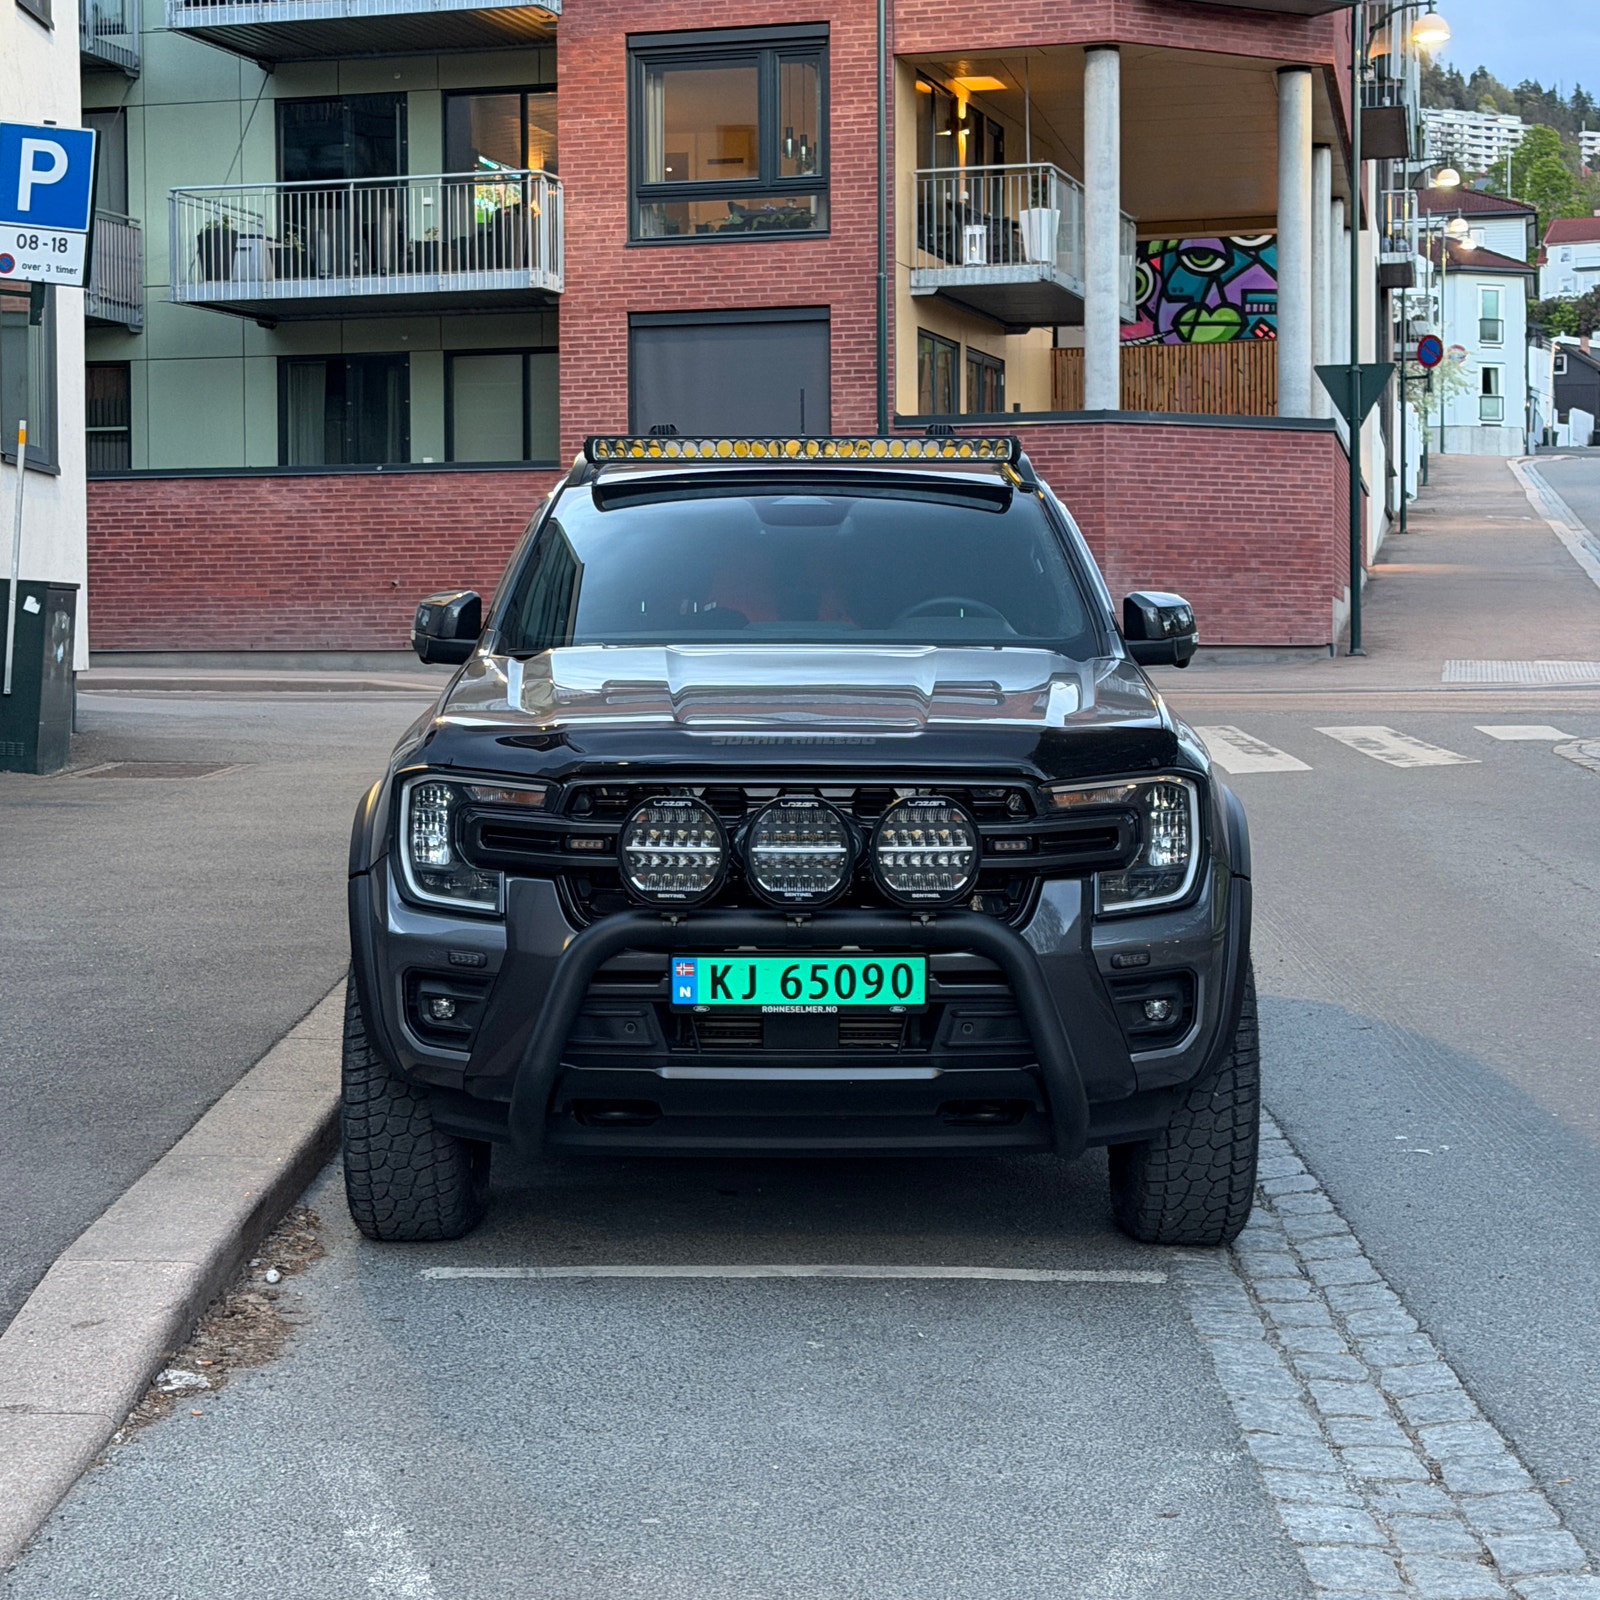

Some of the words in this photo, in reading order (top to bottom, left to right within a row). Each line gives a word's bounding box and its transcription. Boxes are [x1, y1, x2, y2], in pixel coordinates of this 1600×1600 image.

[17, 137, 69, 212] P
[21, 262, 42, 272] over
[45, 263, 52, 273] 3
[55, 265, 79, 275] timer
[679, 986, 692, 998] N
[710, 964, 757, 1000] KJ
[779, 962, 914, 1000] 65090
